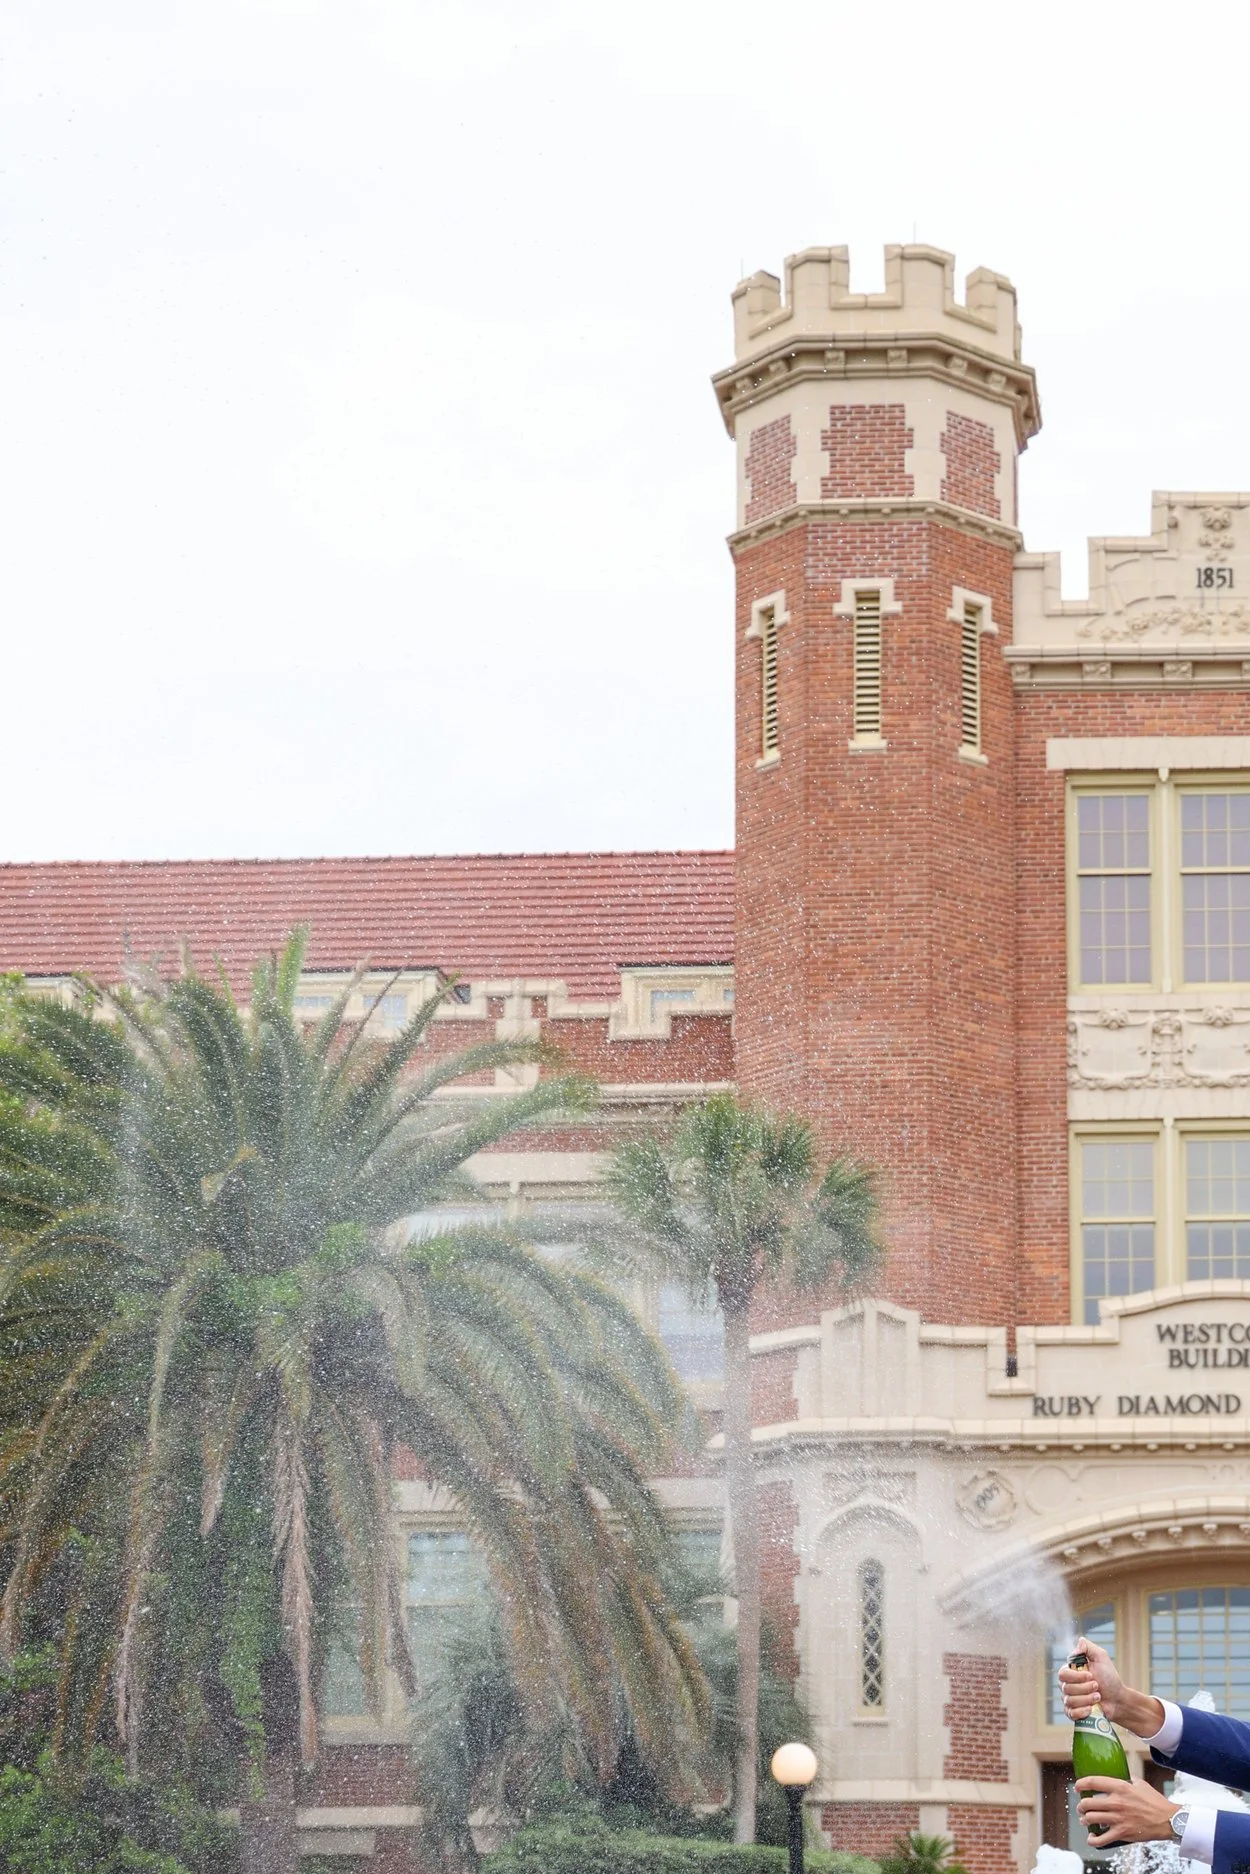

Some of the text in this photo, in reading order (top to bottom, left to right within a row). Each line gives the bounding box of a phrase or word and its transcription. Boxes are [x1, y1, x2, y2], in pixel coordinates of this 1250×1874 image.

[1196, 567, 1234, 589] 1851
[1031, 1395, 1101, 1417] RUBY
[1117, 1393, 1242, 1416] DIAMOND
